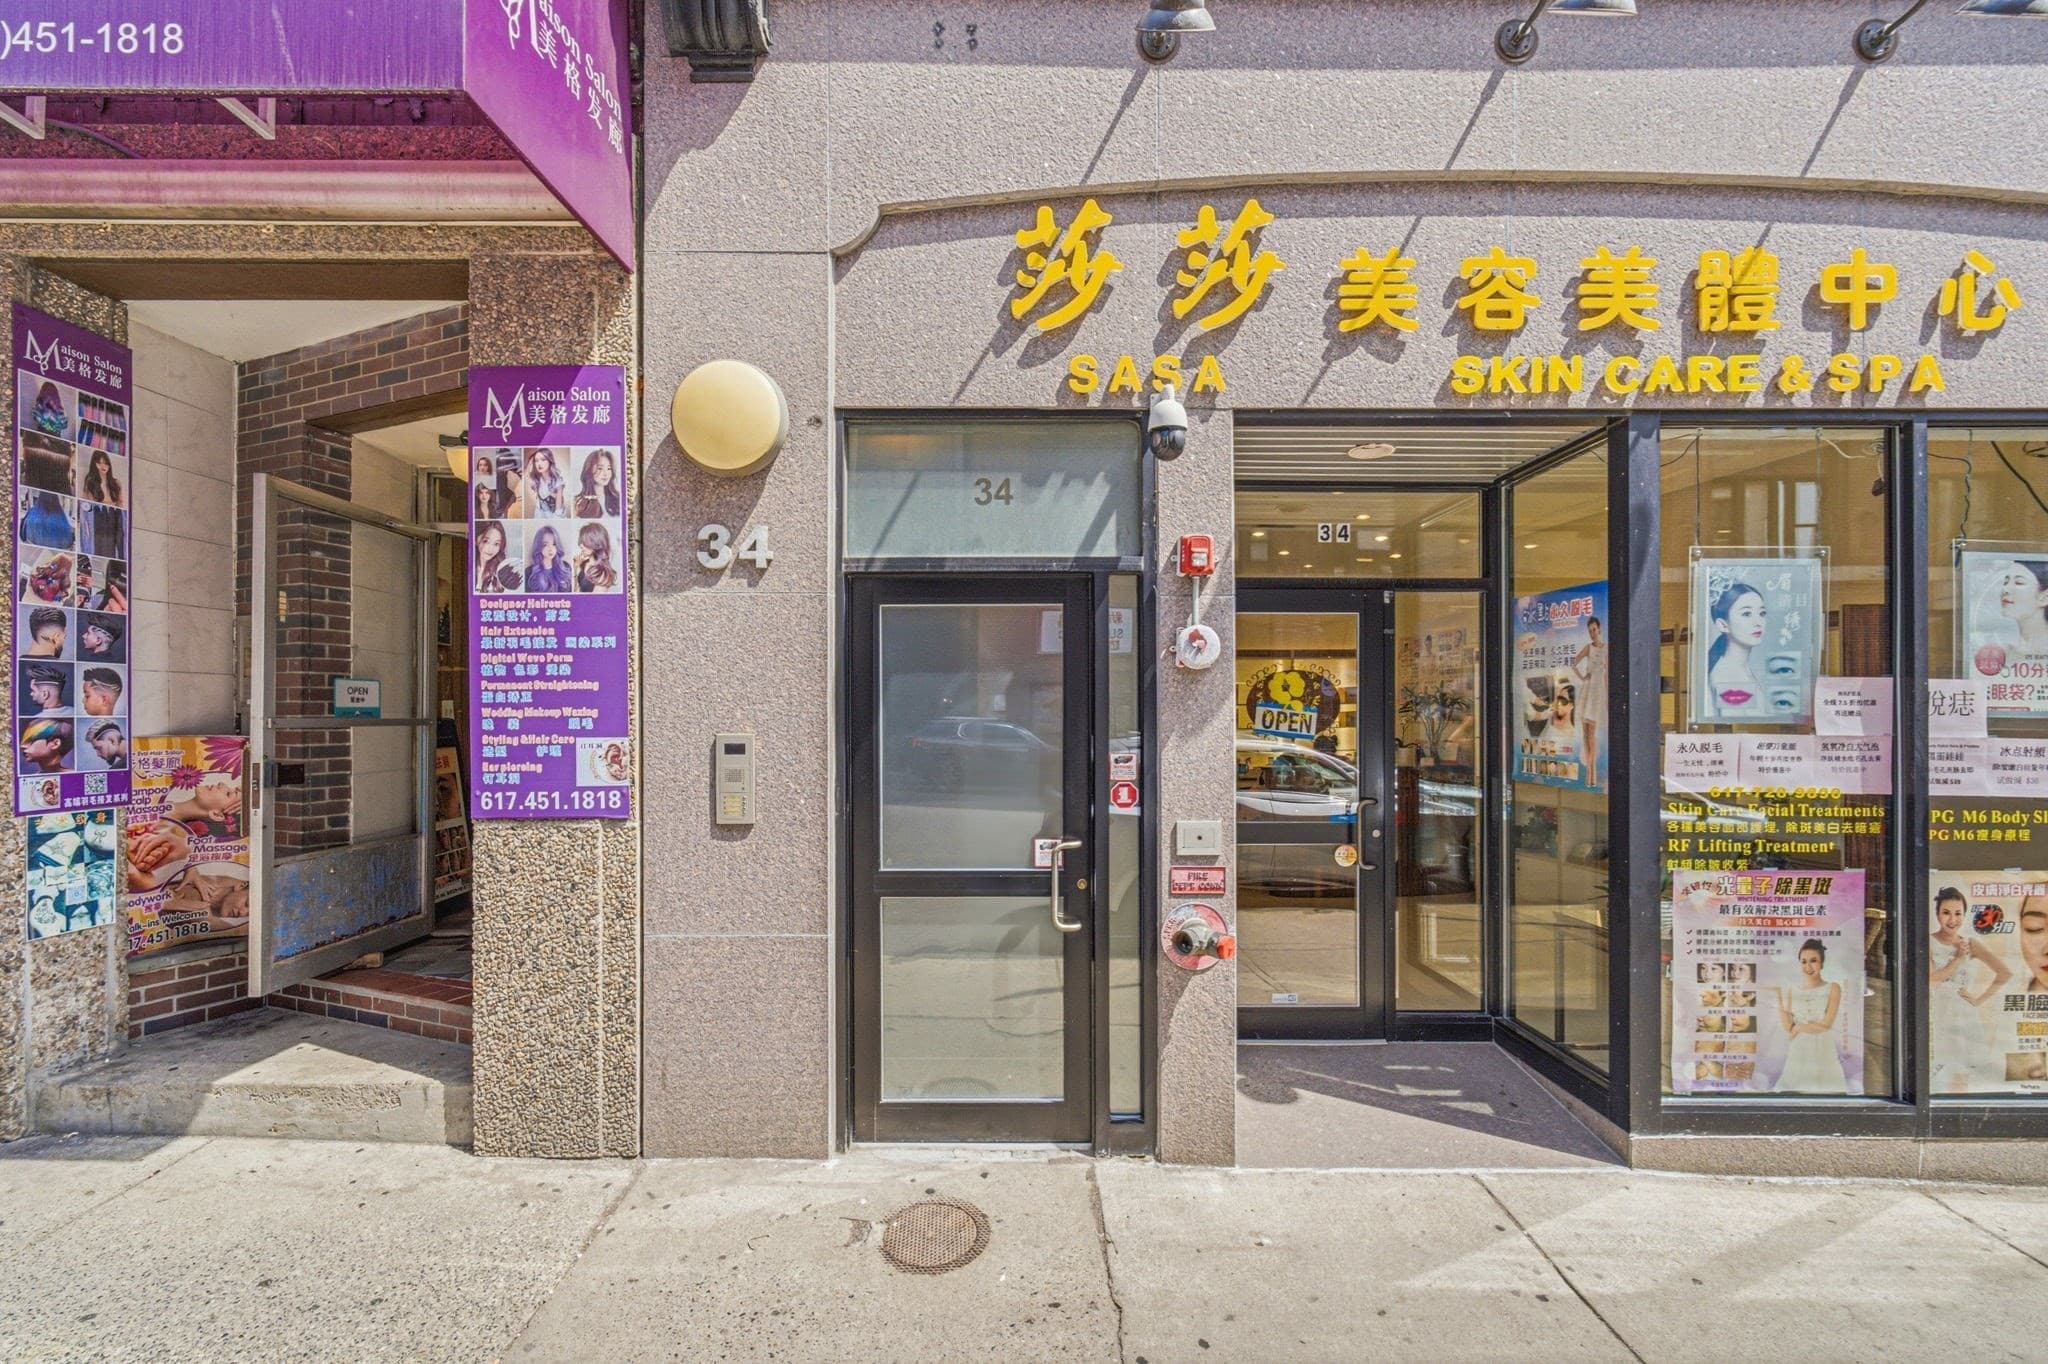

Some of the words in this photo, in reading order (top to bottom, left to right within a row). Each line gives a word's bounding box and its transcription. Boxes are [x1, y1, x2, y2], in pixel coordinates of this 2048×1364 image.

[539, 20, 622, 154] 美格发廊
[586, 53, 622, 122] Salon
[1011, 199, 1287, 332] 莎莎
[1338, 245, 2022, 333] 美容美體中心
[62, 357, 123, 390] 美格发廊
[94, 355, 122, 375] Salon
[1069, 355, 1226, 393] SASA
[1451, 354, 1582, 394] SKIN
[1604, 354, 1763, 394] CARE
[1779, 355, 1811, 393] &
[1828, 354, 1946, 394] SPA
[571, 387, 611, 401] Salon
[528, 405, 611, 425] 美格发廊
[974, 477, 1013, 506] 34
[1318, 524, 1350, 542] 34
[695, 523, 774, 570] 34
[480, 598, 527, 610] Designer
[481, 626, 503, 636] Hair
[504, 626, 555, 636] Extension
[481, 653, 516, 664] Digital
[517, 653, 546, 663] Wave
[546, 653, 573, 663] Perm
[2010, 662, 2048, 678] 10分
[347, 686, 369, 695] OPEN
[482, 707, 523, 719] Wedding
[562, 707, 599, 718] Waxing
[1261, 709, 1313, 734] OPEN
[482, 734, 519, 746] Styling
[551, 734, 575, 744] Care
[481, 790, 622, 810] 617.451.1818
[127, 804, 172, 815] Massage
[1667, 802, 1703, 817] Skin
[1706, 802, 1744, 817] Care
[1748, 802, 1795, 817] Facial
[1798, 802, 1885, 818] Treatments
[1930, 809, 1955, 823] PG
[1962, 809, 1988, 823] M6
[1991, 809, 2030, 827] Body
[187, 836, 213, 845] Foot
[1929, 829, 1949, 841] PG
[193, 844, 248, 855] Massage
[1667, 838, 1691, 853] RF
[1699, 838, 1752, 856] Lifting
[1755, 838, 1835, 853] Treatment
